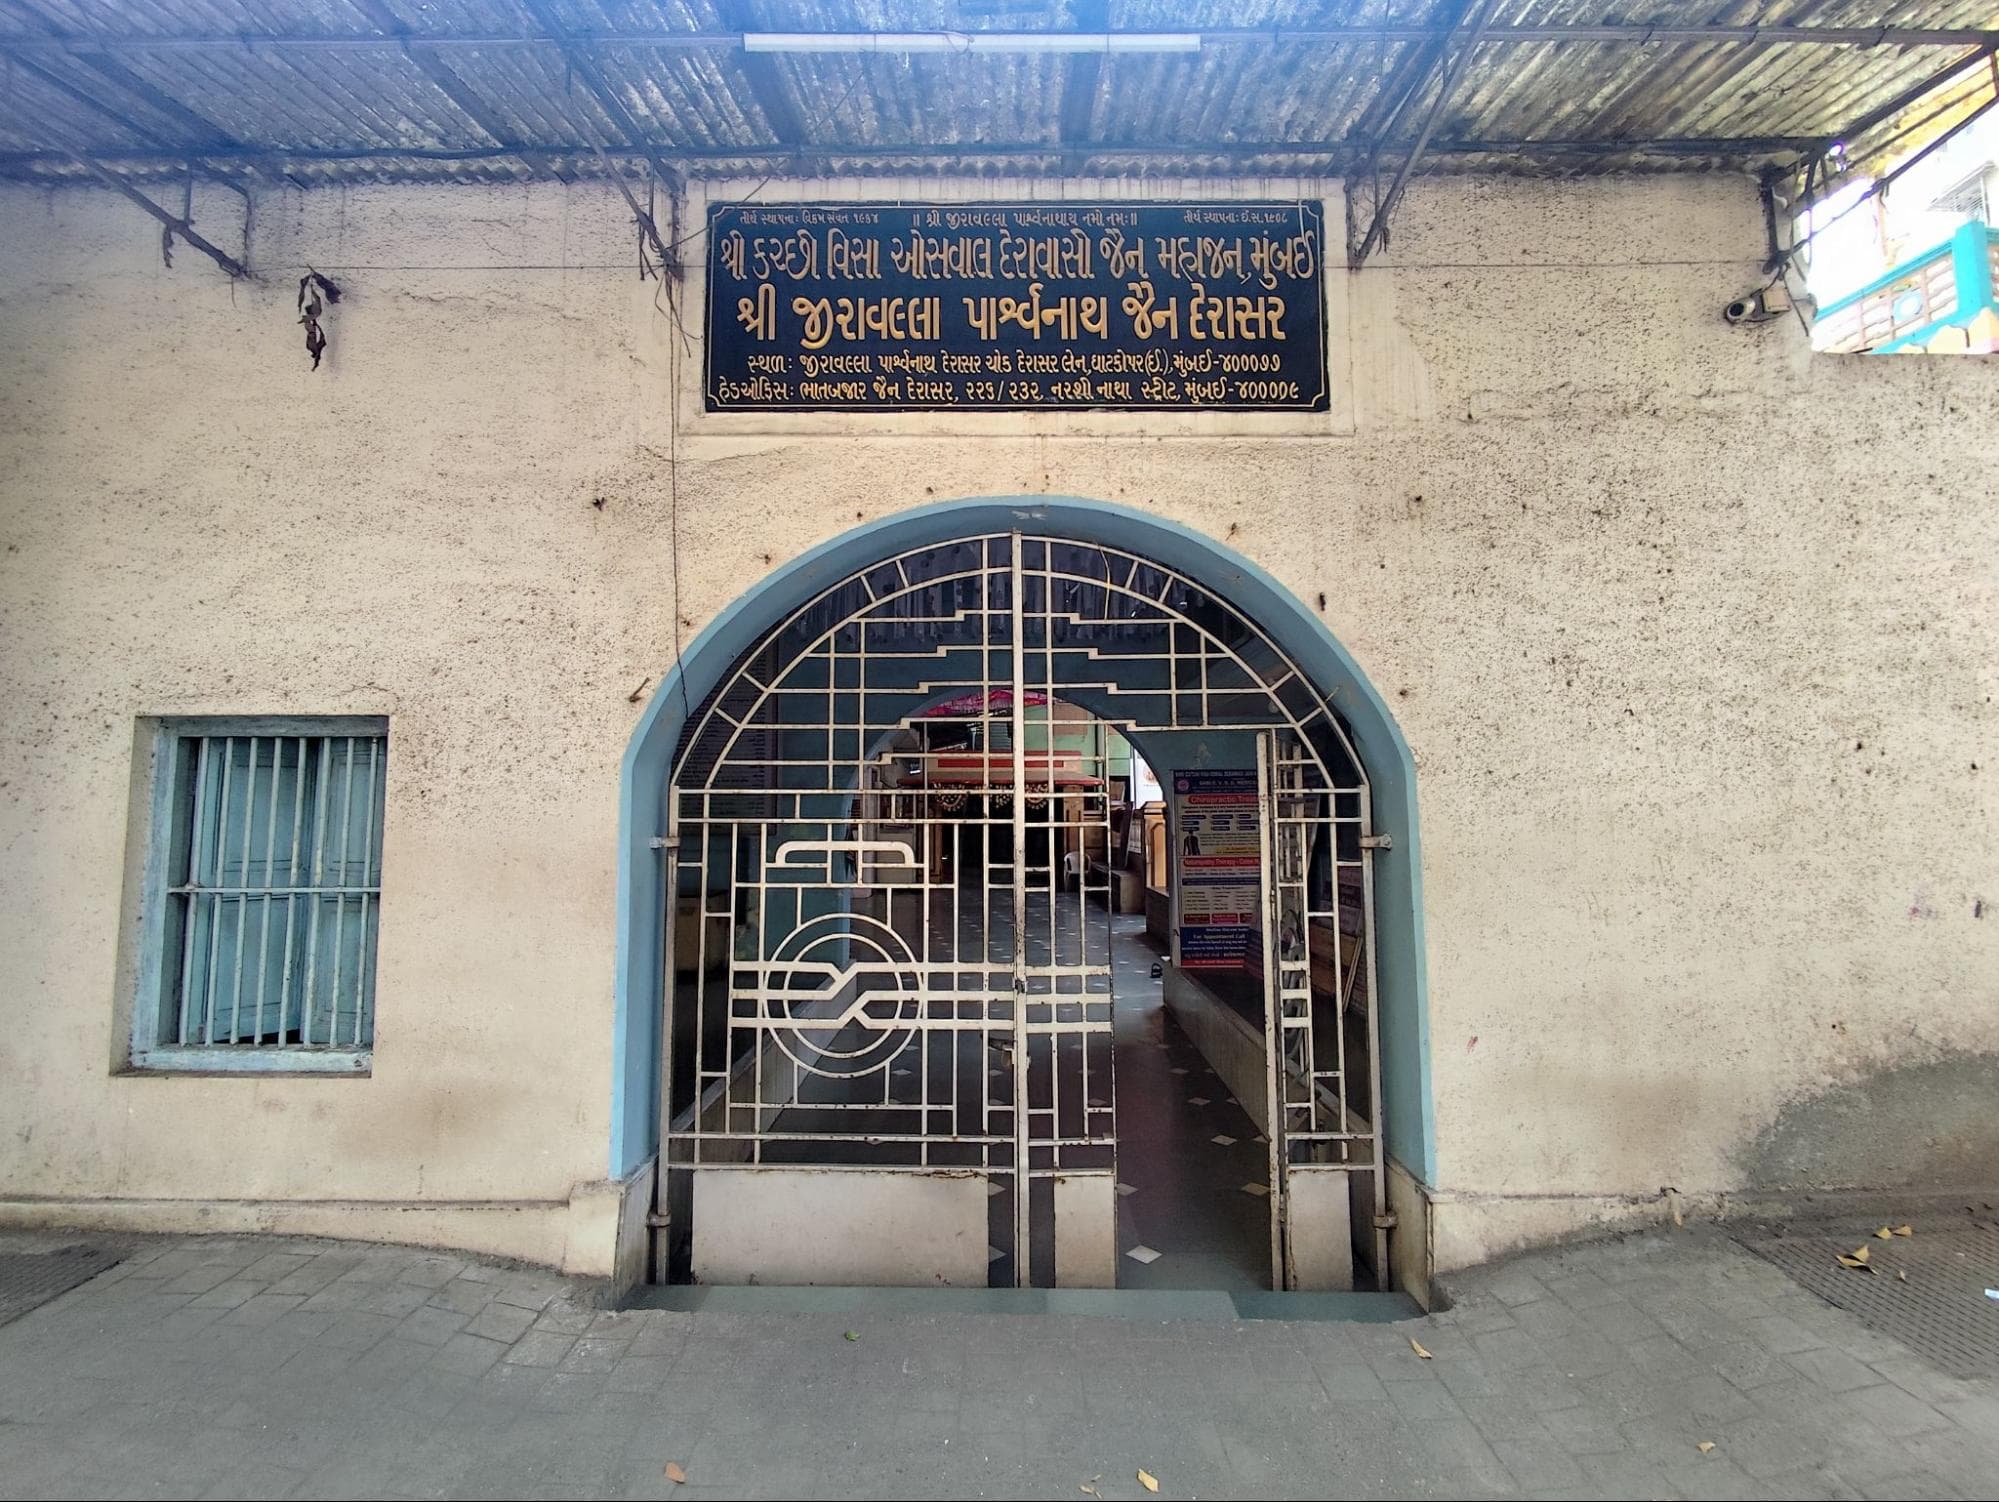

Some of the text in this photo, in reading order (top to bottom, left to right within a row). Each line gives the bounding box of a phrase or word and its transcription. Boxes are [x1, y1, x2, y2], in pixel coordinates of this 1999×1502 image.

[926, 209, 942, 227] શ્રી
[945, 212, 1007, 230] જીરાવલ્લા
[1082, 208, 1105, 227] નમો
[720, 229, 748, 280] શ્રી
[752, 228, 821, 280] કચ્છી
[827, 227, 882, 280] વિસા
[890, 228, 994, 280] ઓસવાલ
[999, 227, 1096, 280] દેરાવાસી
[1099, 227, 1149, 279] જૈન
[736, 280, 1287, 350] શ્રી જીરાવલ્લા પાર્શ્વનાથ જૈન દેરાસર
[799, 355, 873, 378] જીરાવલ્લા
[877, 348, 938, 375] પાર્શ્વનાથ
[940, 349, 983, 375] દેરાસર
[985, 349, 1013, 375] ચોક
[1016, 349, 1059, 374] દેરાસર
[799, 381, 868, 401] ભાતબજાર
[872, 375, 902, 401] જૈન
[1050, 376, 1094, 401] નરશી
[1096, 381, 1133, 401] નાથા
